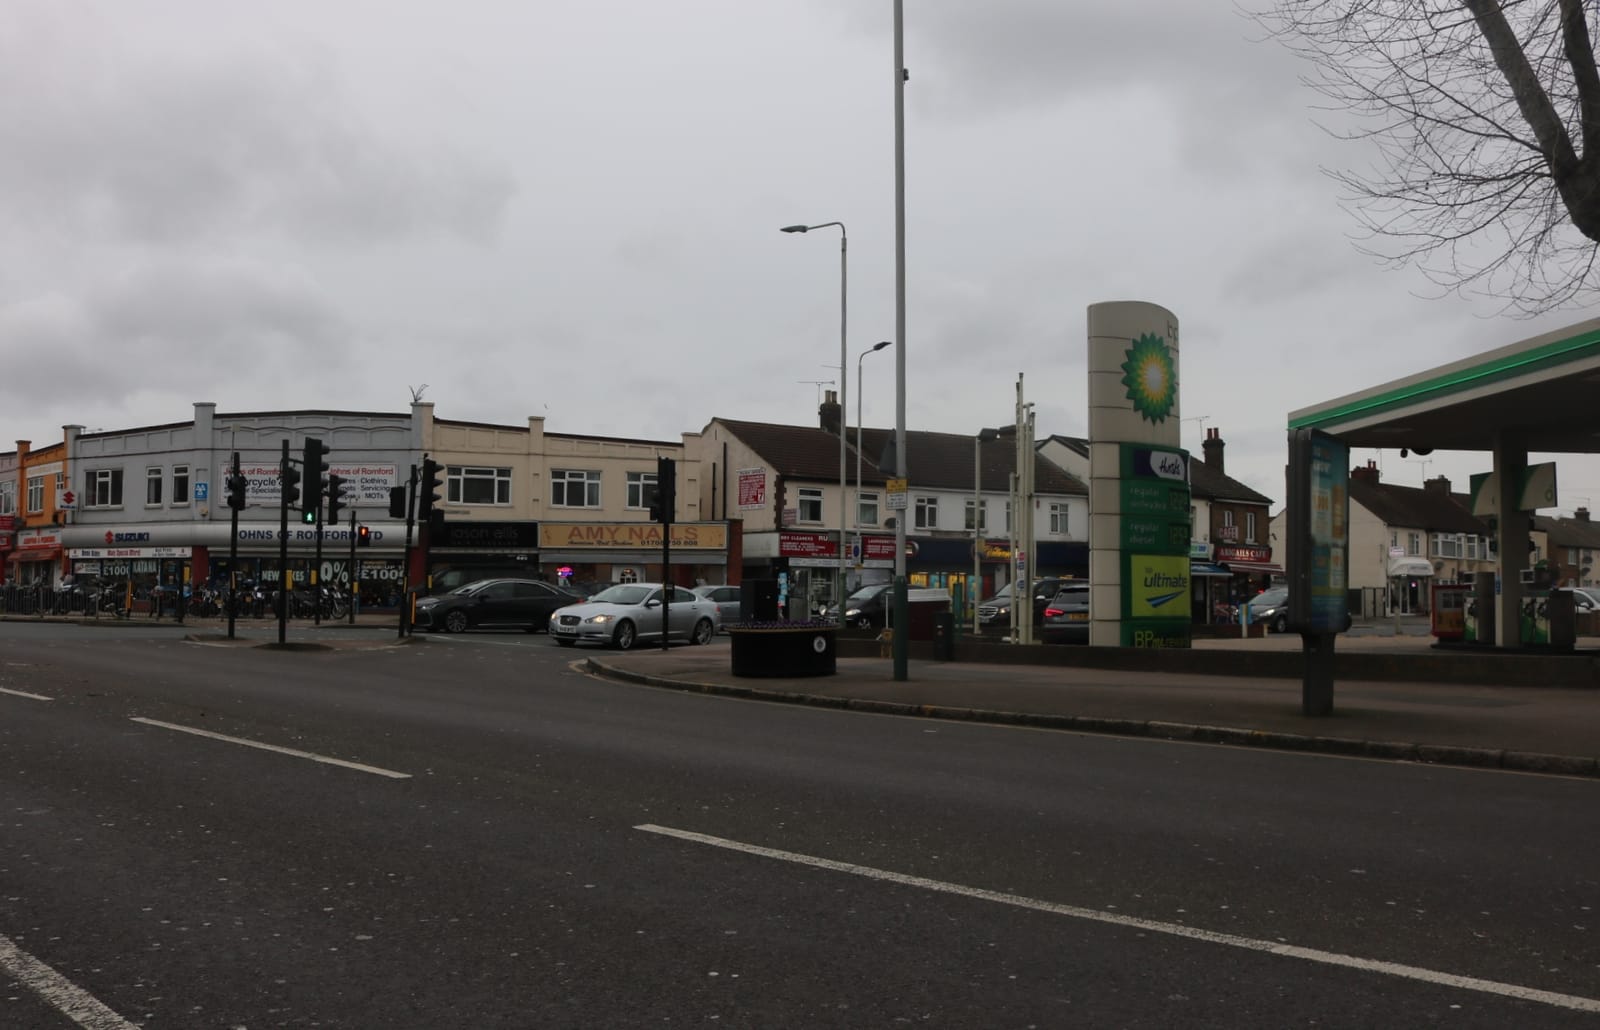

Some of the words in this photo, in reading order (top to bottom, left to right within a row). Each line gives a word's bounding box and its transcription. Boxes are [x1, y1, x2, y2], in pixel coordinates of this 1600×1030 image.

[360, 477, 388, 485] Clothing
[115, 532, 150, 542] SUZUKI
[568, 526, 620, 540] AMY
[628, 527, 698, 541] NALS
[1143, 572, 1188, 588] ultimate
